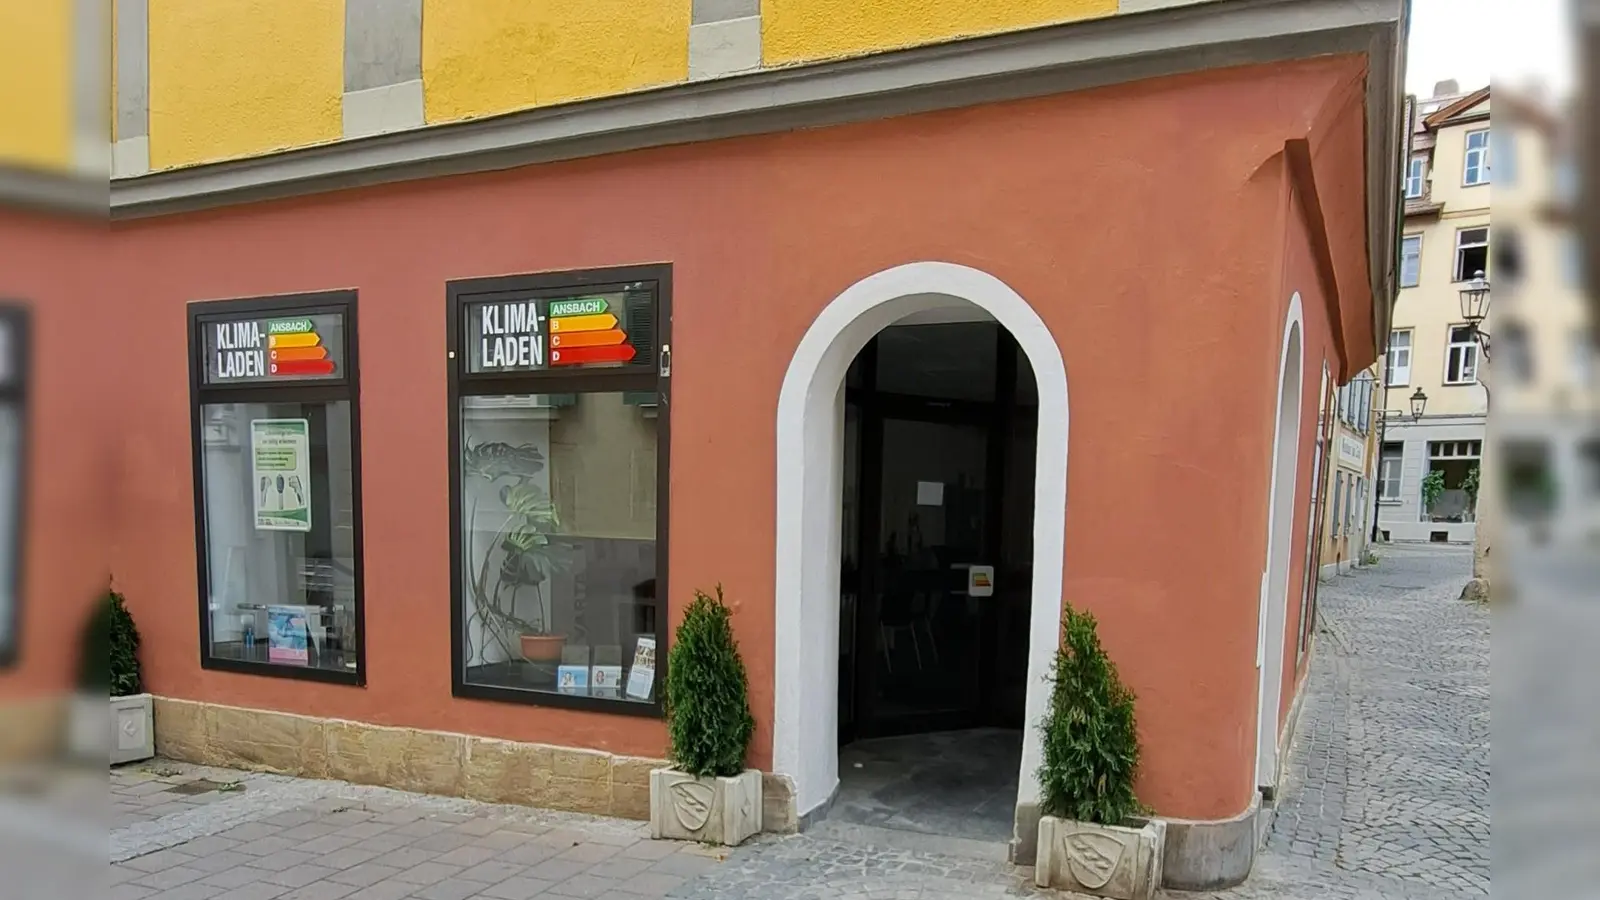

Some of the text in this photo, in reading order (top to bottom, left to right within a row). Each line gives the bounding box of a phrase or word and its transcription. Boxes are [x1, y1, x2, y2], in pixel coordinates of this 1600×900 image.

[552, 302, 600, 315] ANSBACH
[482, 303, 545, 334] KLIMA-
[269, 321, 307, 332] ANSBACH
[553, 320, 560, 329] B
[216, 321, 265, 349] KLIMA-
[552, 336, 560, 346] C
[270, 350, 277, 359] C
[482, 335, 542, 367] LADEN
[552, 351, 560, 361] D
[218, 350, 264, 377] LADEN
[270, 364, 277, 373] D
